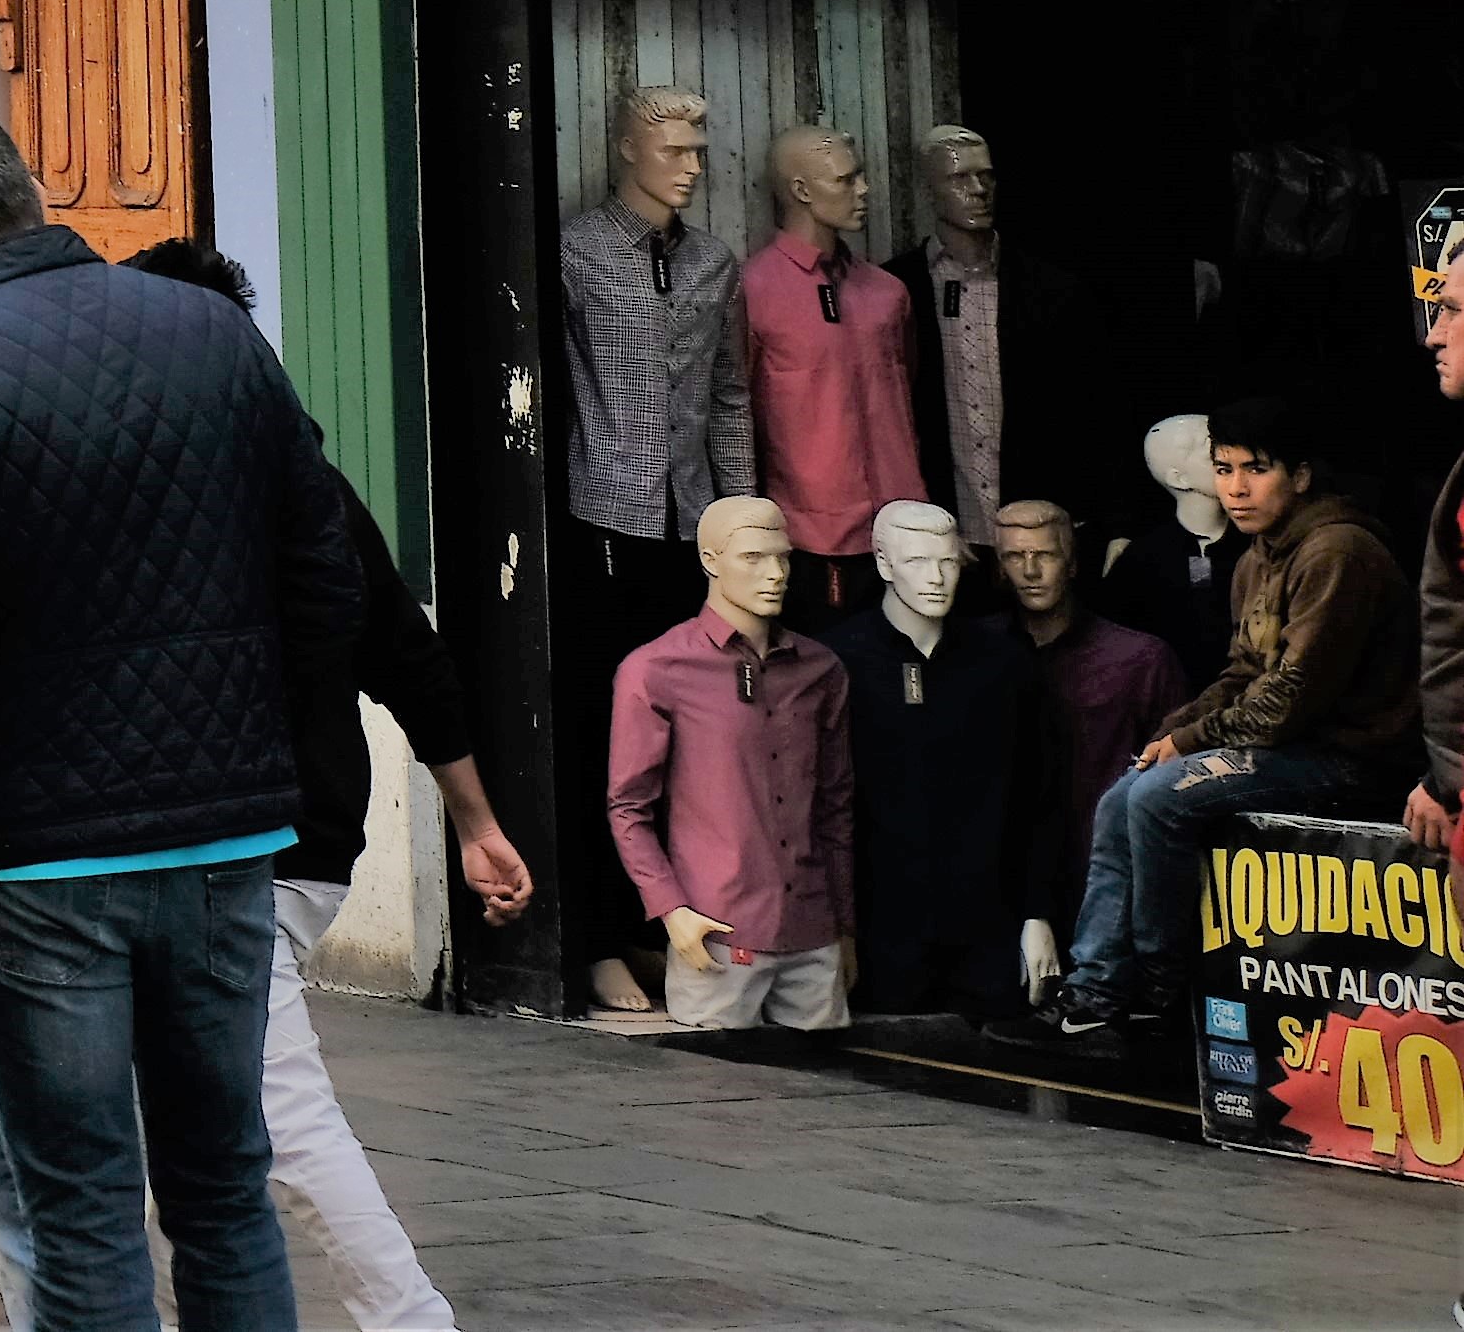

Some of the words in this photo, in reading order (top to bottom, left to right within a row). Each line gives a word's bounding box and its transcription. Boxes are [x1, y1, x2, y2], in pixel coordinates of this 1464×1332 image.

[1214, 1090, 1250, 1107] pierre
[1337, 1026, 1464, 1166] 40
[1216, 1102, 1254, 1119] cardin
